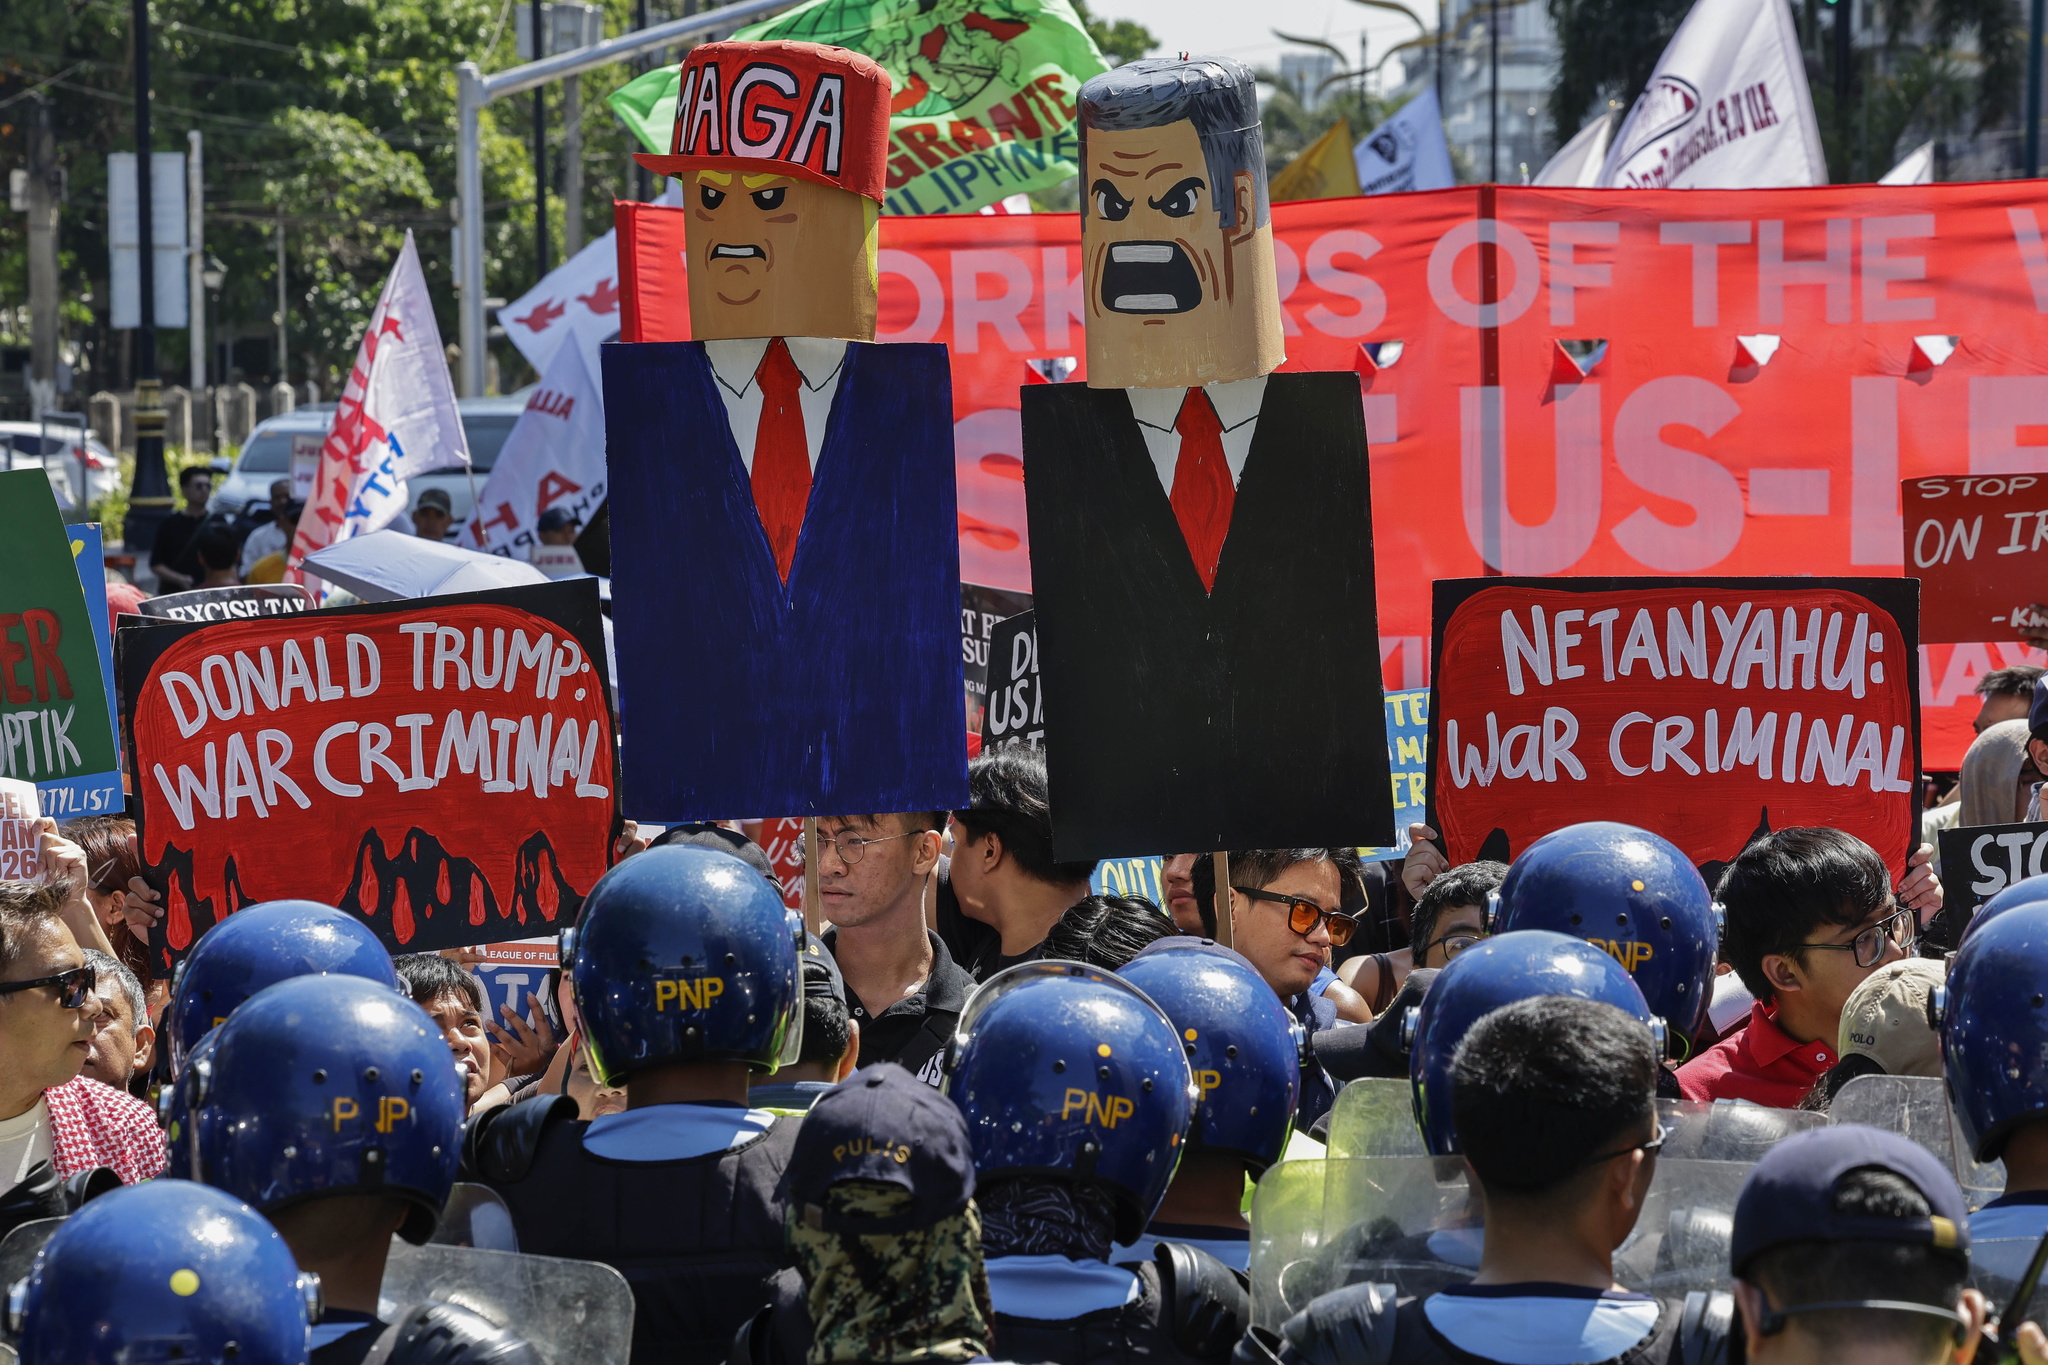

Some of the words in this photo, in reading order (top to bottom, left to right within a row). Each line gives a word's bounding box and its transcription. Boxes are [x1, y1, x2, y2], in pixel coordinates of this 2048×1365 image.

[676, 61, 845, 178] MAGA
[1427, 218, 1620, 328] OF
[1659, 213, 1936, 327] THE
[1917, 475, 2038, 499] STOP
[1913, 514, 1983, 569] ON
[1501, 600, 1885, 697] NETANYAHU:
[160, 634, 381, 739] DONALD
[399, 621, 590, 702] TRUMP:
[153, 728, 312, 831] WAR
[313, 709, 609, 800] CRIMINAL
[1608, 706, 1913, 793] CRIMINAL
[0, 849, 37, 880] 26
[486, 951, 522, 961] LEAGUE
[523, 951, 537, 961] OF
[655, 976, 724, 1012] PNP
[1849, 1032, 1875, 1046] POLO
[1061, 1087, 1135, 1129] PNP
[832, 1137, 912, 1164] PULIS
